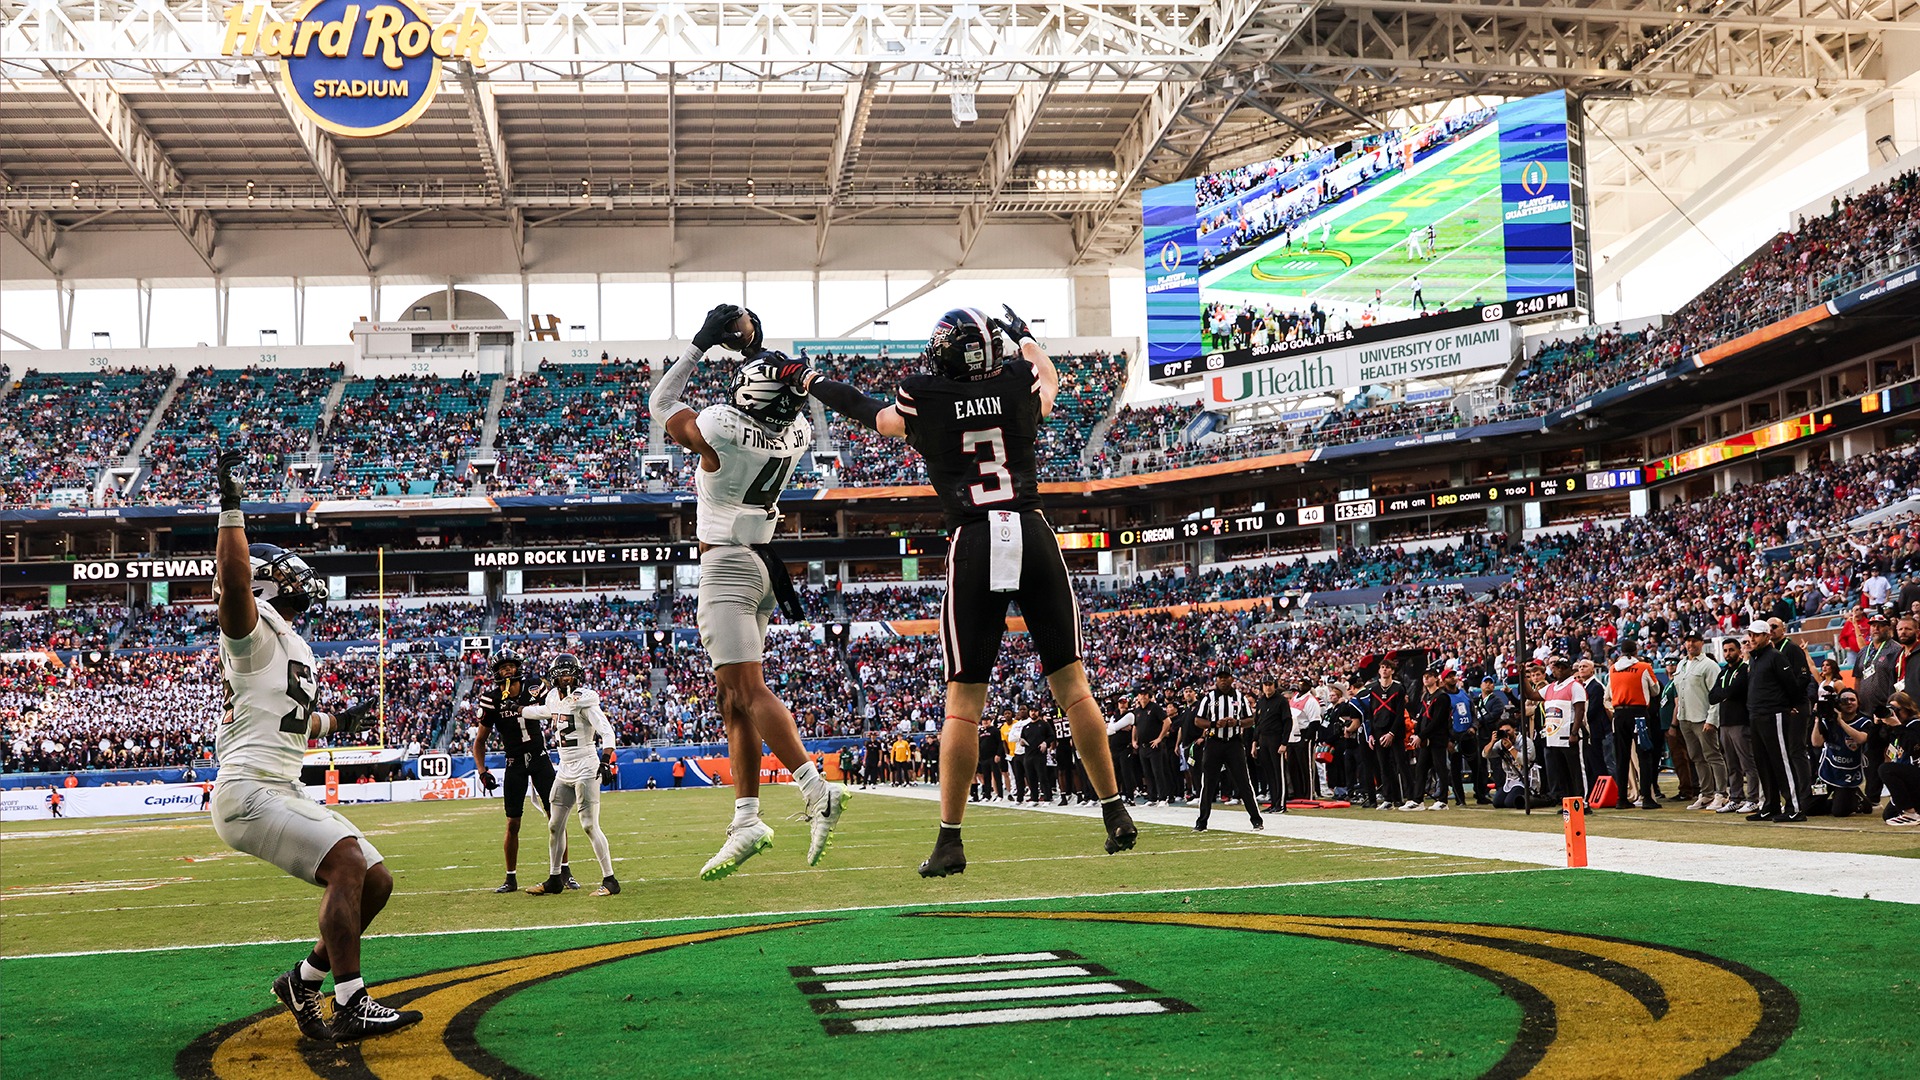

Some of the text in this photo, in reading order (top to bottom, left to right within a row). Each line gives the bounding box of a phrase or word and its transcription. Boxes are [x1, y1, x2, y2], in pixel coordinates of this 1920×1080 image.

[221, 4, 488, 69] Hard Rock
[313, 79, 409, 98] STADIUM
[1505, 200, 1568, 220] QUARTERFINAL
[1518, 194, 1554, 210] PLAYOFF
[1515, 292, 1568, 315] 2:40 PM
[1484, 308, 1500, 319] CC
[1251, 344, 1270, 357] 3RD
[1270, 340, 1289, 352] AND
[1289, 336, 1315, 350] GOAL
[1315, 334, 1326, 345] AT
[1327, 331, 1345, 343] THE
[1359, 328, 1500, 365] UNIVERSITY OF MIAMI
[89, 357, 109, 366] 330
[260, 354, 277, 363] 331
[571, 349, 589, 358] 333
[1208, 355, 1223, 367] CC
[411, 363, 430, 372] 332
[1184, 360, 1192, 374] F
[1360, 352, 1461, 382] HEALTH SYSTEM
[1406, 388, 1450, 401] BUD LIGHT
[954, 396, 1002, 419] EAKIN
[793, 429, 805, 448] JR
[962, 427, 1015, 505] 3
[742, 456, 792, 521] 4
[1540, 469, 1636, 491] BALL 9 2:40 PM
[1544, 487, 1556, 496] ON
[1141, 527, 1175, 543] OREGON
[1182, 524, 1199, 537] 13
[1235, 516, 1263, 532] TTU
[1276, 512, 1285, 526] 0
[1304, 509, 1318, 521] 40
[1338, 503, 1374, 519] 13:50
[1390, 499, 1408, 511] 4TH
[1411, 499, 1426, 508] QTR
[1437, 494, 1458, 506] 3RD
[1459, 492, 1481, 501] DOWN
[1488, 487, 1498, 500] 9
[1504, 487, 1515, 496] TO
[1515, 486, 1527, 495] GO
[474, 551, 519, 567] HARD
[524, 550, 567, 565] ROCK
[572, 549, 606, 564] LIVE
[621, 548, 649, 562] FEB
[655, 547, 671, 560] 27
[73, 562, 120, 580] ROD
[470, 638, 483, 647] 40
[499, 710, 521, 719] TEXA
[1459, 717, 1470, 725] 221
[1053, 721, 1072, 739] 85
[423, 758, 447, 776] 40
[1590, 778, 1607, 804] 10
